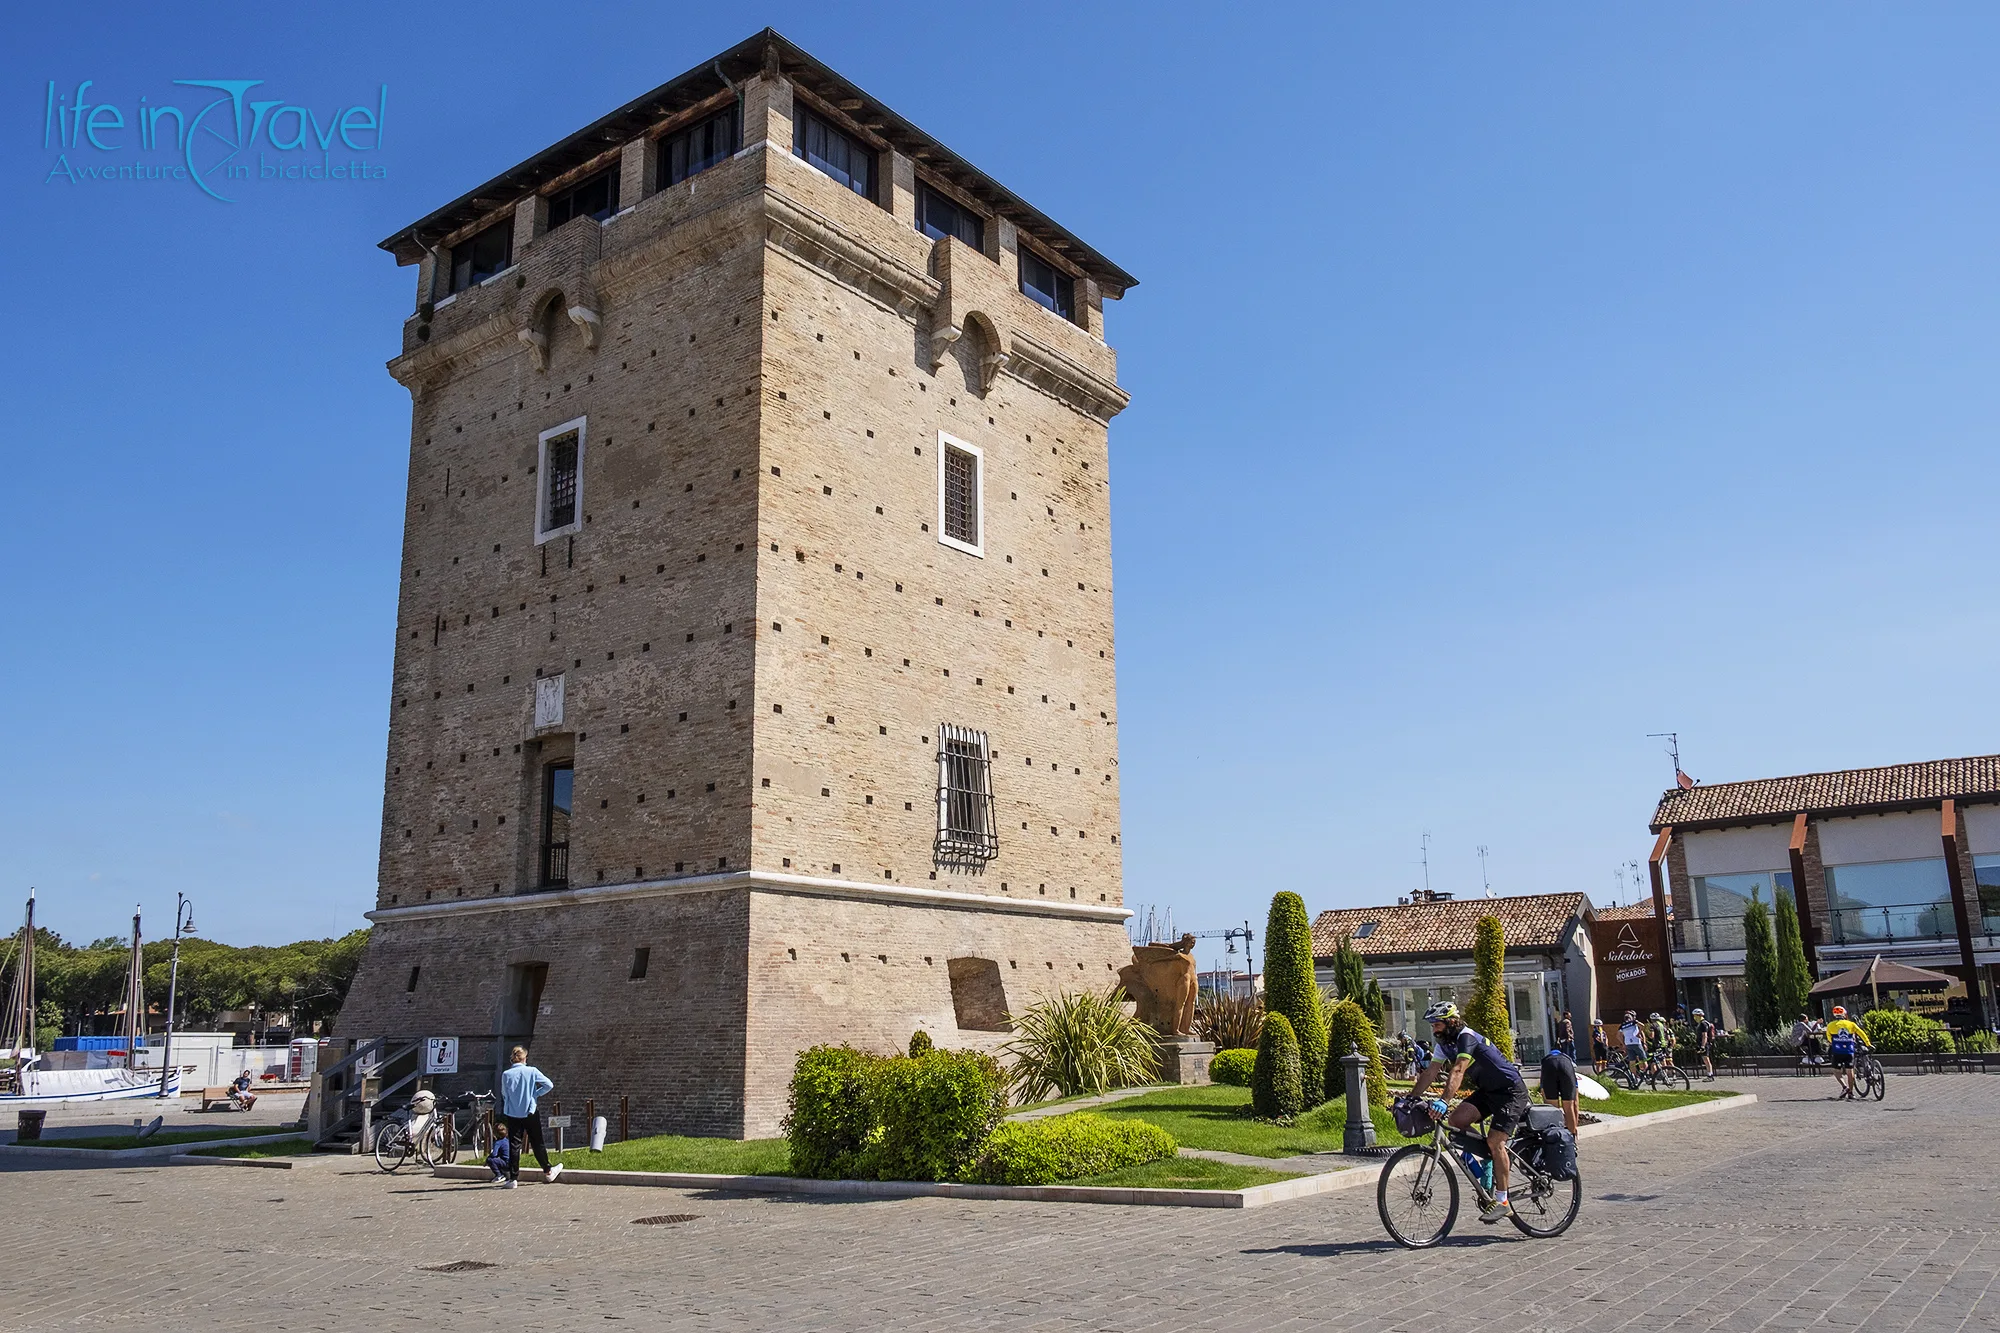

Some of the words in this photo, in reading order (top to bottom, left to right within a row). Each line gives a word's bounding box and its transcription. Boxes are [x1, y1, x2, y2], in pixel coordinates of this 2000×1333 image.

[1603, 950, 1653, 961] Saledolce
[1616, 968, 1646, 981] MOKADOR
[431, 1039, 438, 1047] R
